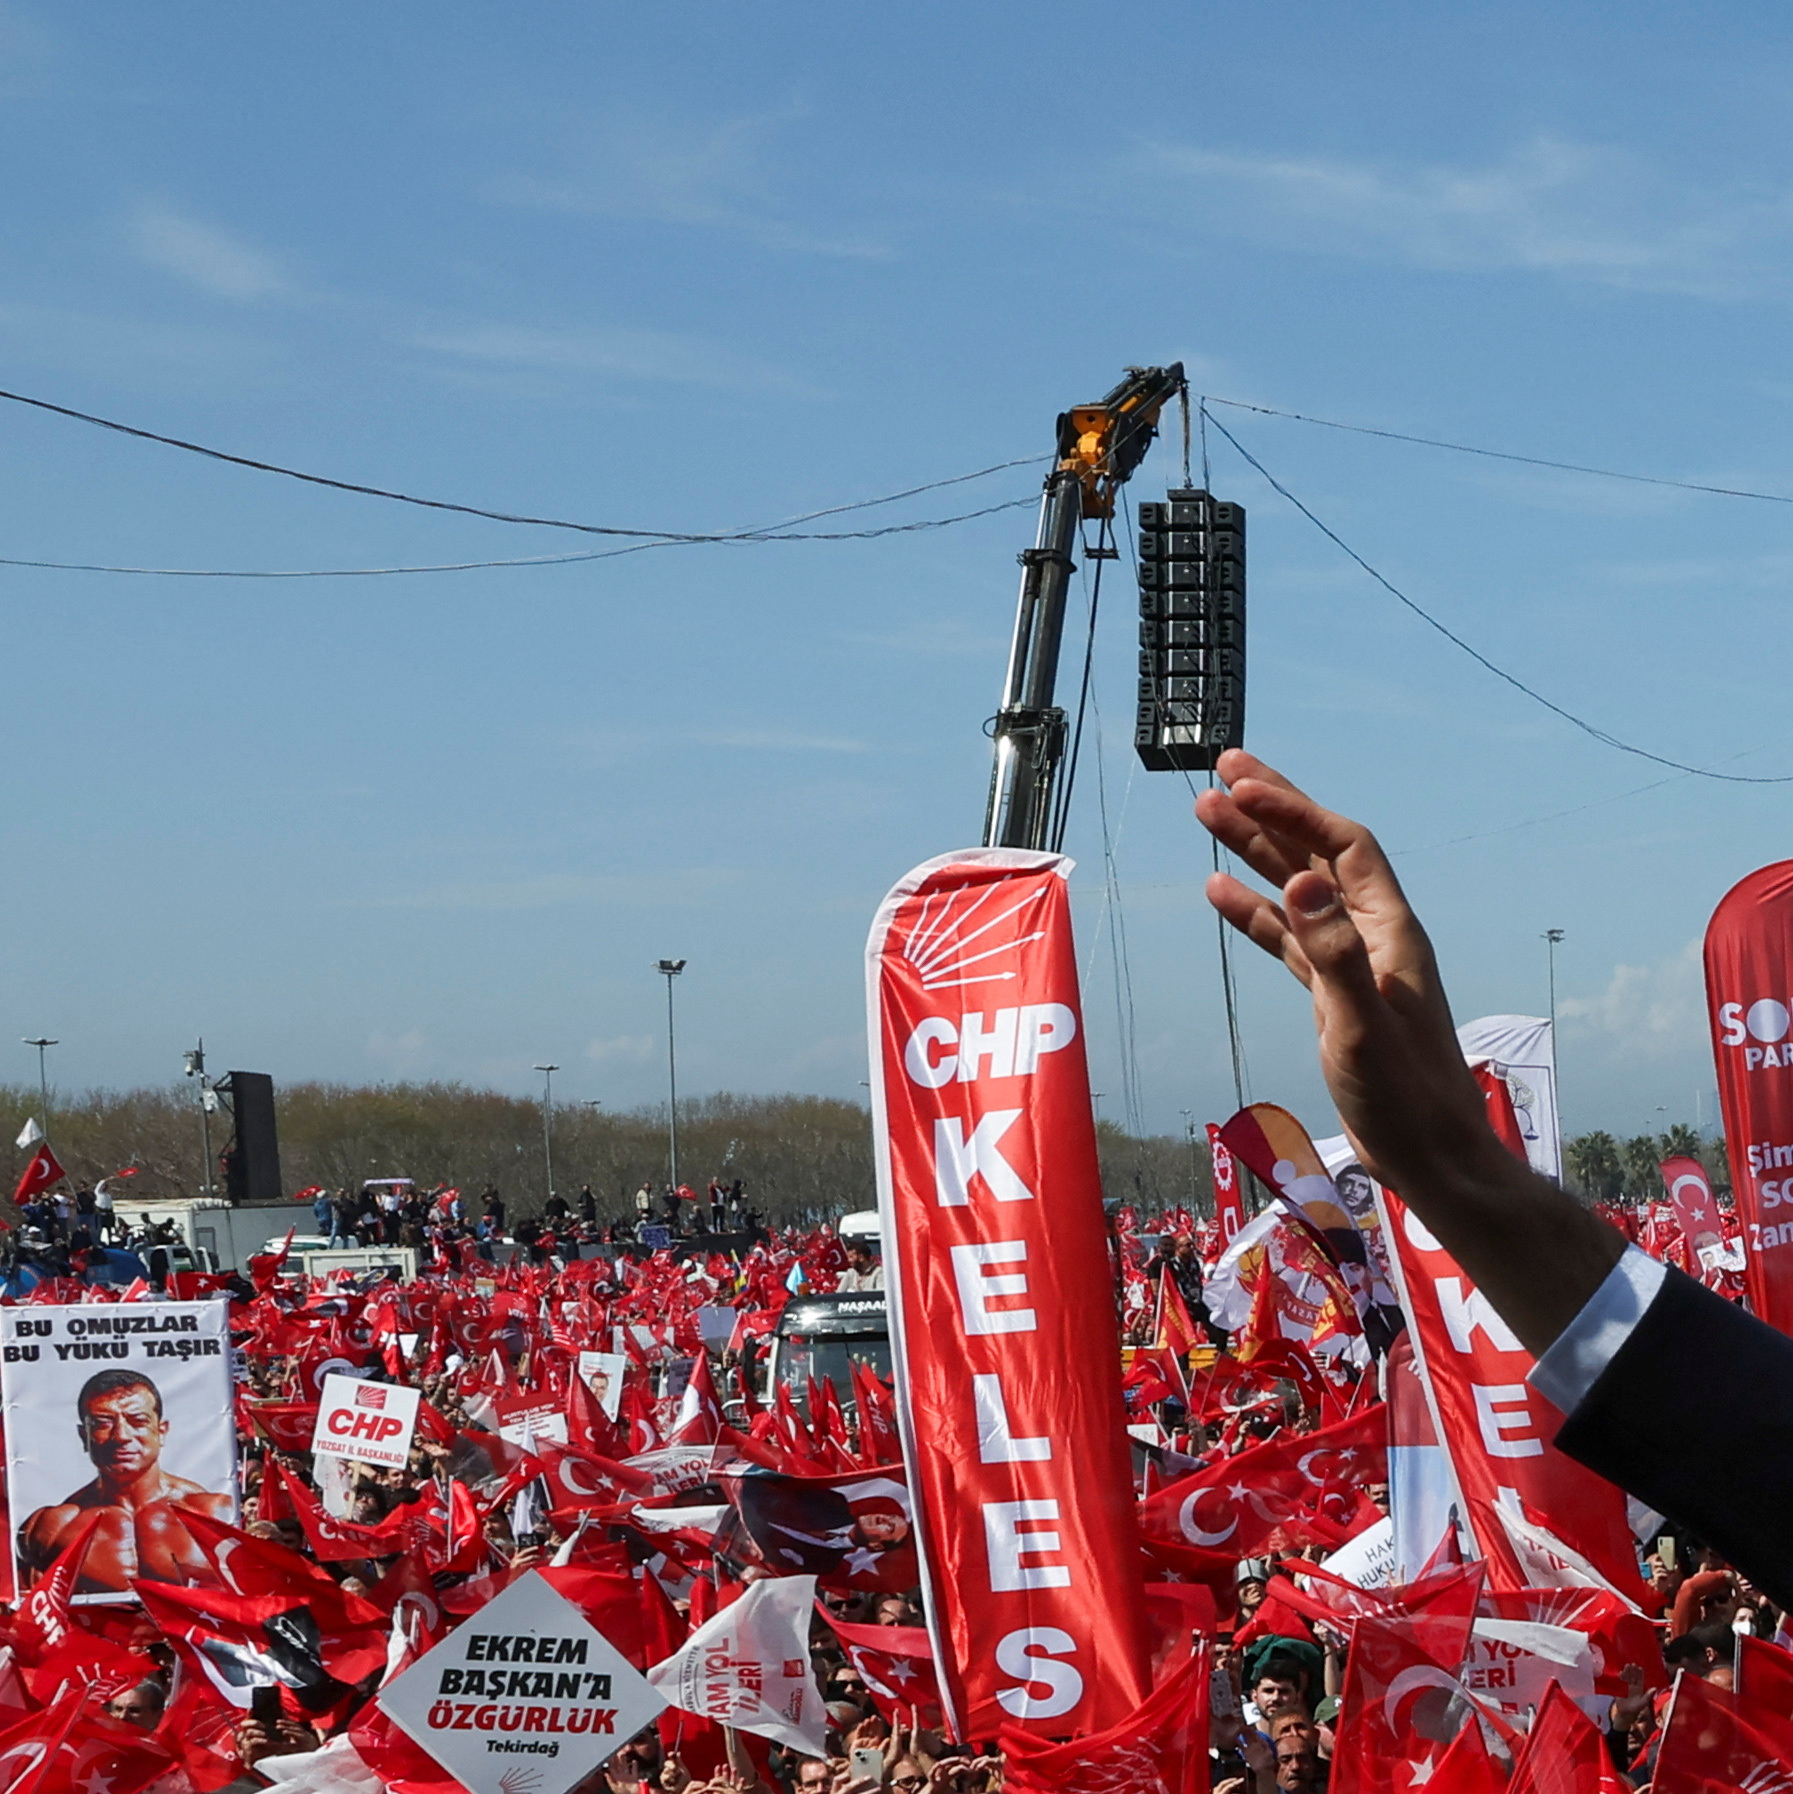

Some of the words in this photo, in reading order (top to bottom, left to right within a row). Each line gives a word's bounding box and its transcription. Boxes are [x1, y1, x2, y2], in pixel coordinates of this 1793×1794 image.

[905, 1003, 1076, 1089] CHP
[838, 1300, 888, 1314] MAŞAAL
[15, 1319, 53, 1337] BU
[66, 1315, 199, 1336] OMUZLAR
[3, 1344, 41, 1363] BU
[53, 1336, 130, 1361] YÜKÜ
[142, 1339, 222, 1362] TAŞIR
[328, 1408, 403, 1442] CHP
[934, 1108, 1083, 1720] KELES
[316, 1440, 346, 1453] YOZGAT
[347, 1445, 355, 1456] İL
[356, 1447, 405, 1463] BAŞKANLIĞI
[465, 1634, 589, 1665] EKREM
[704, 1637, 731, 1680] YOL
[438, 1668, 612, 1701] BAŞKAN'A
[486, 1740, 560, 1758] Tekirdağ
